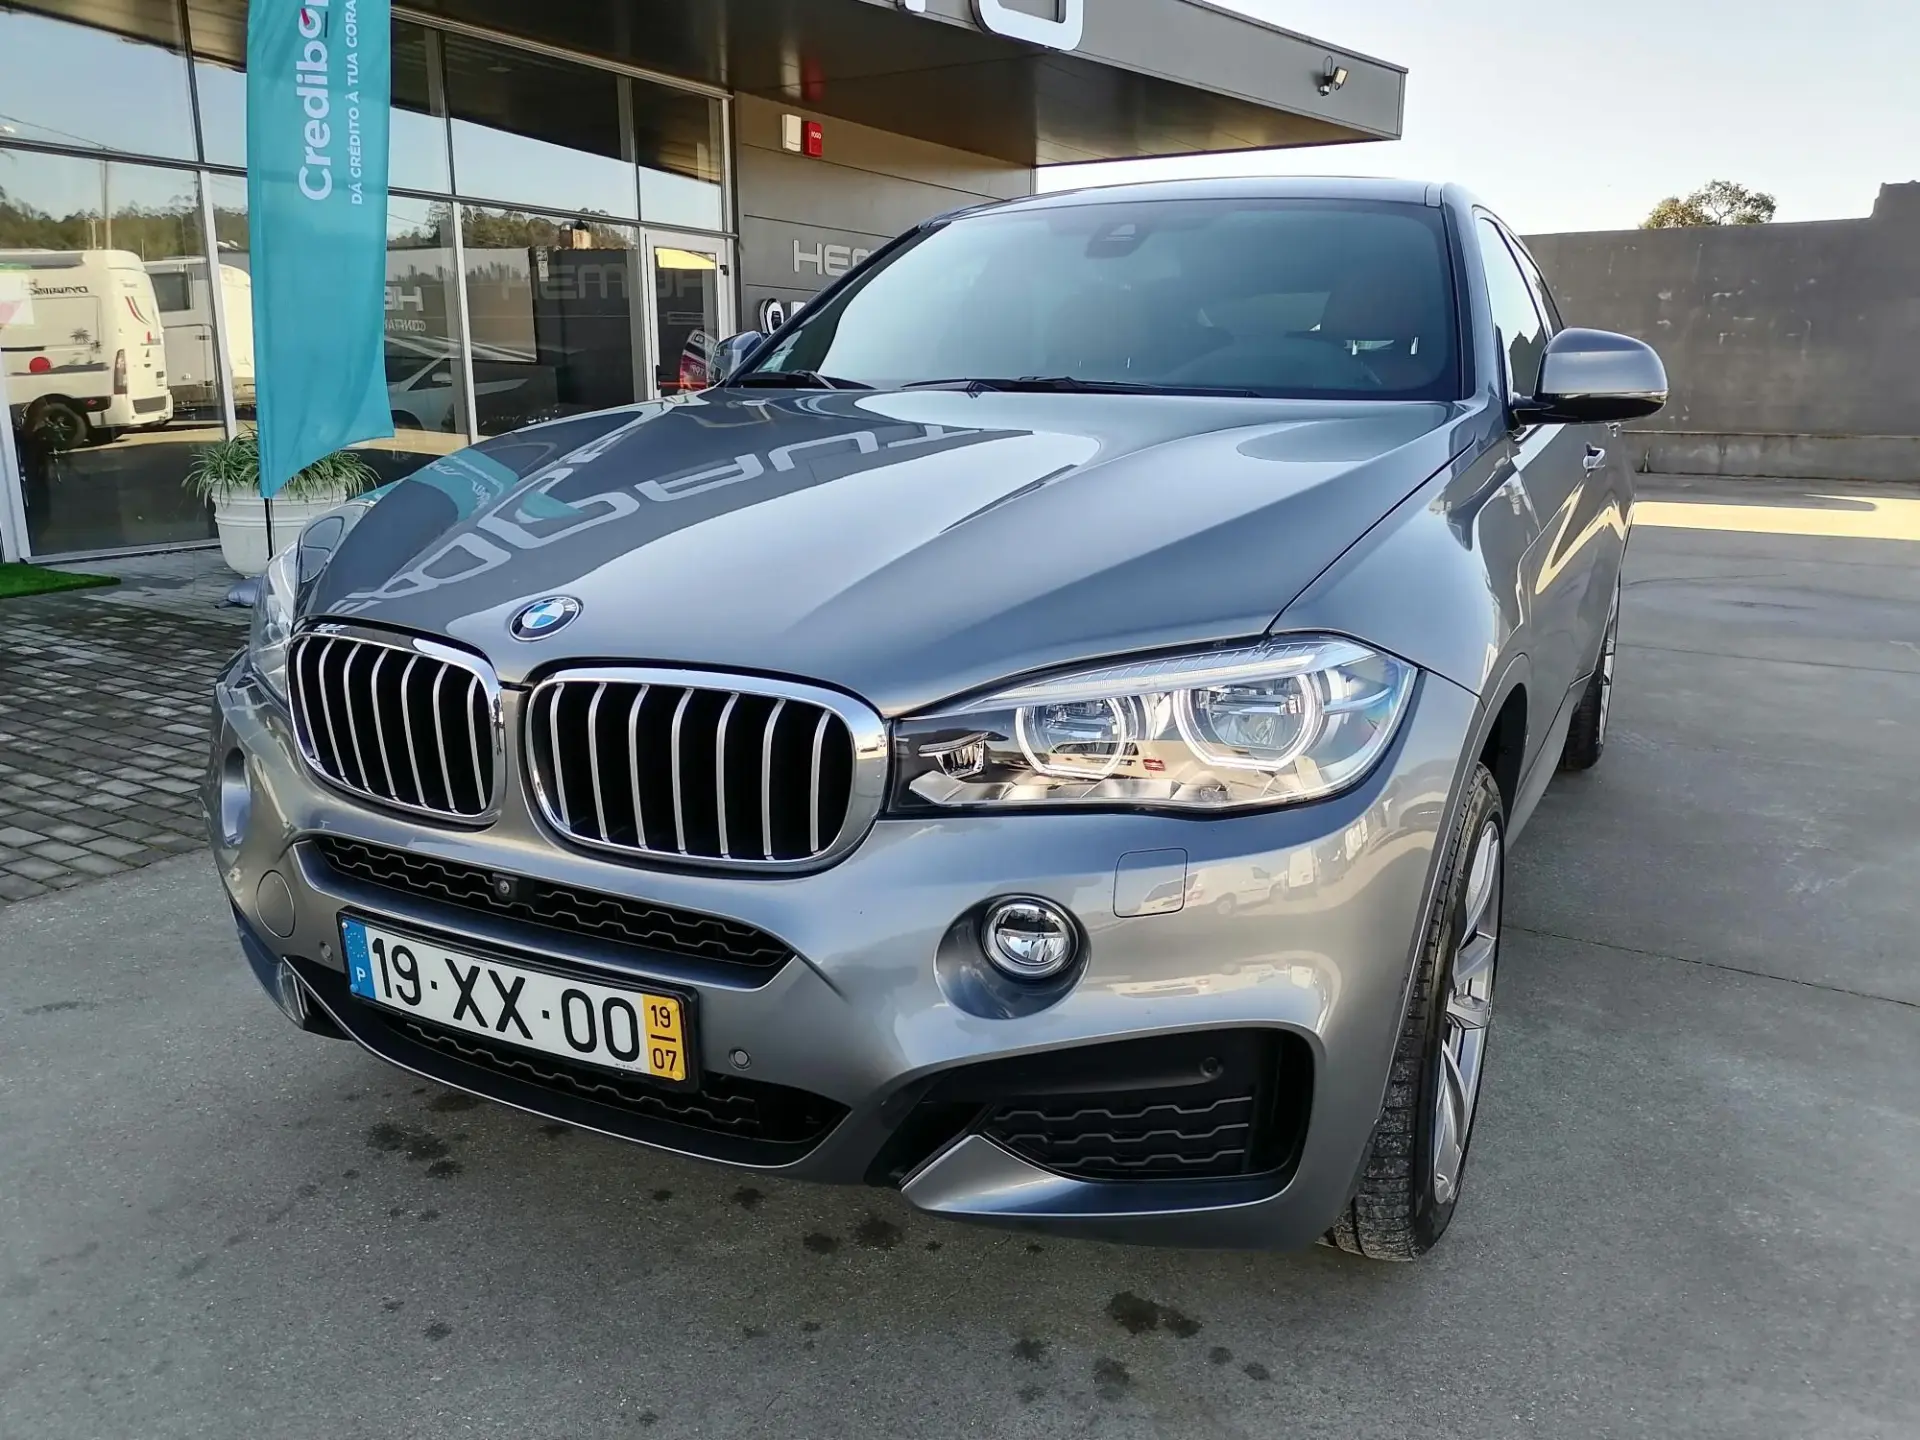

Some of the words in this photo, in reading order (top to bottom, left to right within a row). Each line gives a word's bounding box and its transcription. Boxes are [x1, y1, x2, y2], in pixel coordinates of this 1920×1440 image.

[346, 52, 359, 86] TUA
[296, 0, 333, 200] Credibo
[345, 91, 359, 104] À
[347, 107, 362, 178] CRÉDITO
[348, 182, 363, 205] DÁ
[355, 966, 366, 982] P
[650, 1004, 671, 1028] 19
[652, 1047, 677, 1072] 07
